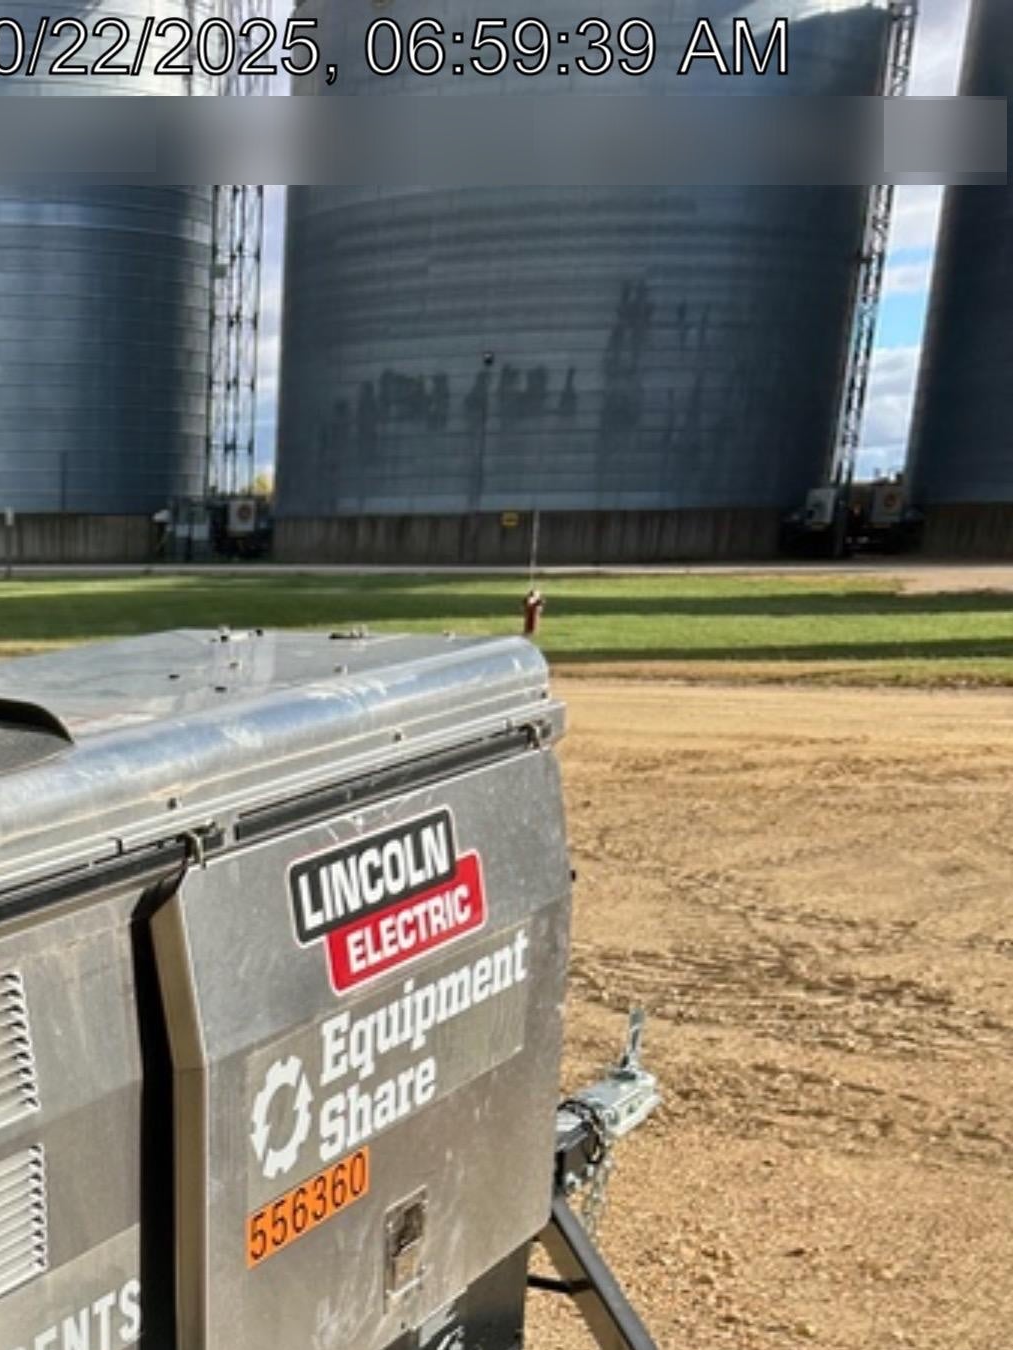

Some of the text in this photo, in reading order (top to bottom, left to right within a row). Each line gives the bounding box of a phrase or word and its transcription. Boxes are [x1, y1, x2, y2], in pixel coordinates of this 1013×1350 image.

[299, 822, 451, 930] LINCOLN
[346, 884, 472, 973] ELECTRIC
[320, 928, 529, 1086] Equipment
[318, 1055, 436, 1162] Share
[250, 1152, 366, 1260] 556360
